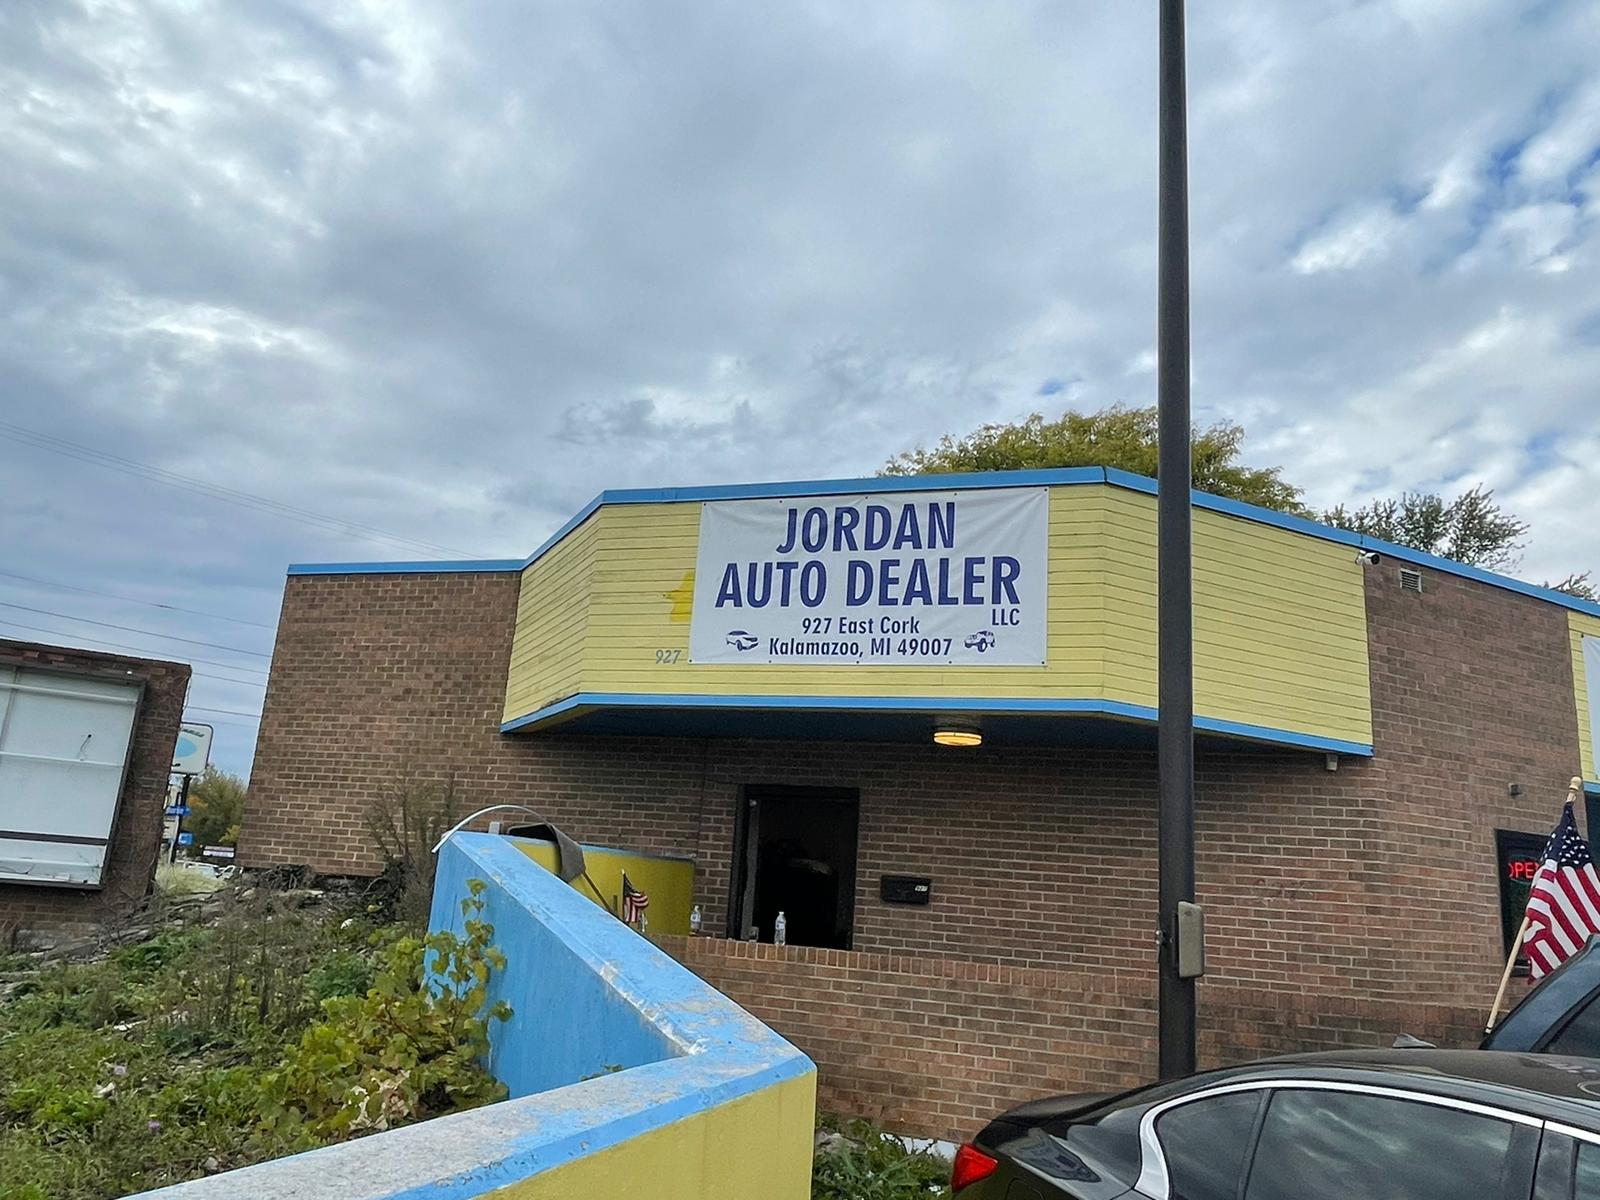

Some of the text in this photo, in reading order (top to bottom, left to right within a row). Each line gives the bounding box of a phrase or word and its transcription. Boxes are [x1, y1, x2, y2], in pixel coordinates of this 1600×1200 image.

[776, 502, 956, 553] JORDAN
[715, 556, 1021, 608] AUTO DEALER
[802, 615, 920, 635] 927 East Cork
[991, 608, 1021, 626] LLC
[655, 649, 682, 665] 927
[769, 637, 953, 658] Kalamazoo, MI 49007
[1508, 861, 1540, 879] PE
